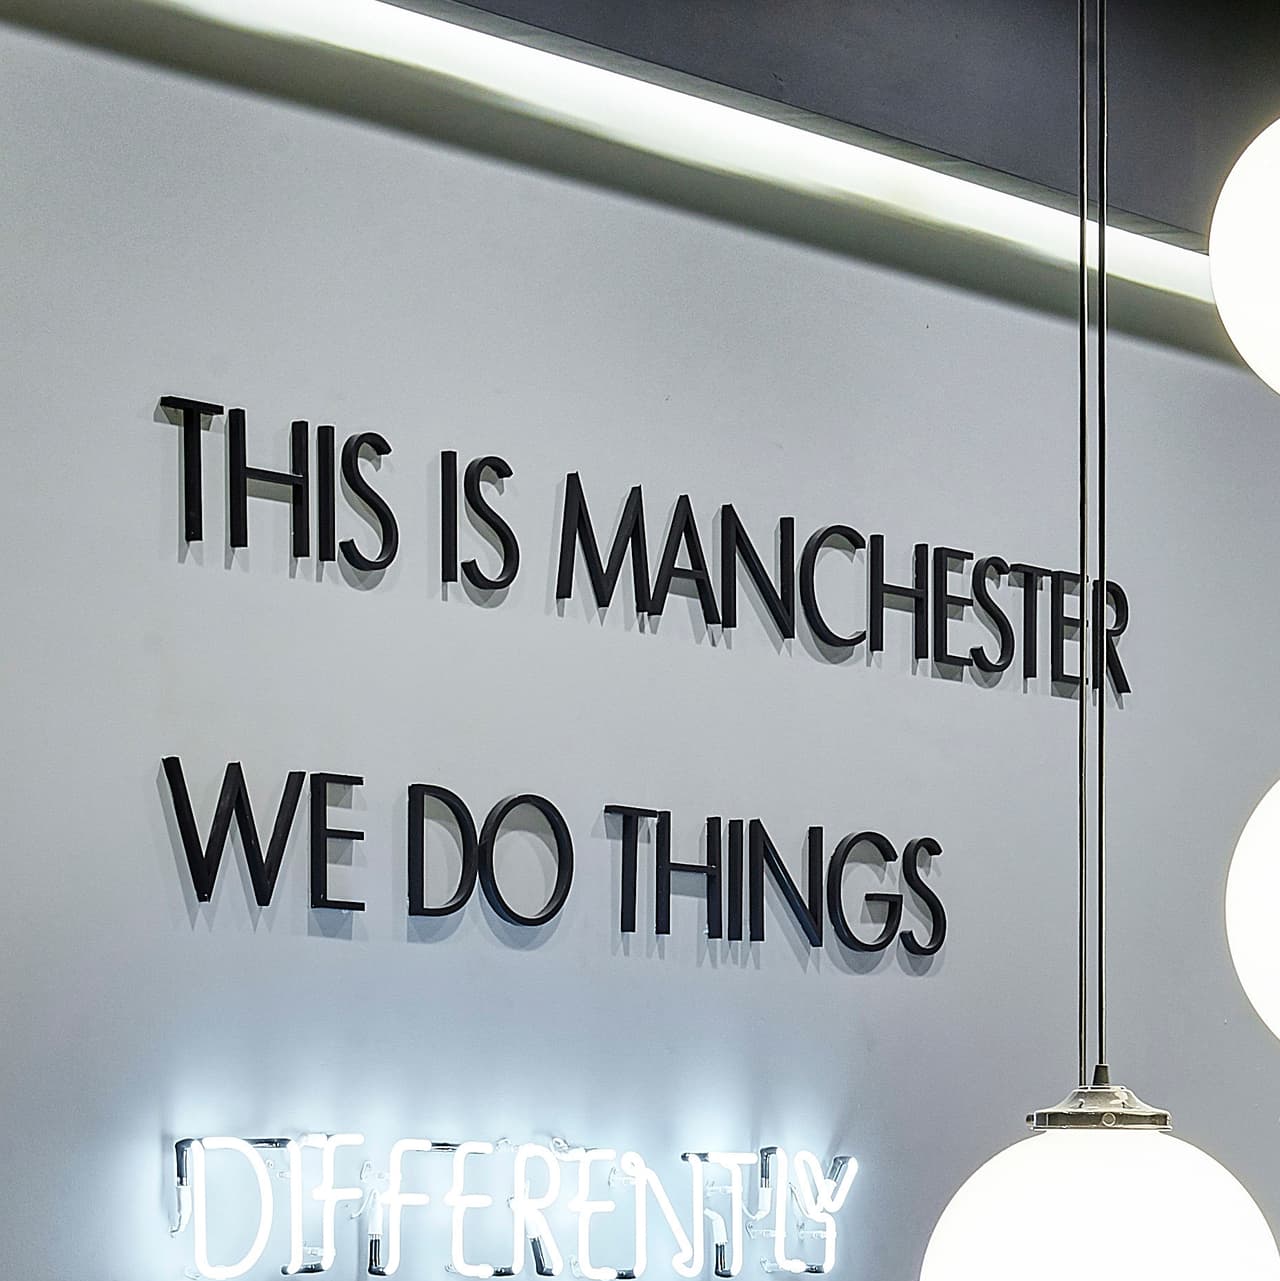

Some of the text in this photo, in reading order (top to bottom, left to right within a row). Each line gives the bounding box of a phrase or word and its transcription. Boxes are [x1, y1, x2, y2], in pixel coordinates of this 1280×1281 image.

[160, 396, 1132, 694] THIS IS MANCHESTER
[161, 755, 948, 956] WE DO THINGS
[191, 1133, 859, 1280] DIFFERENTLY
